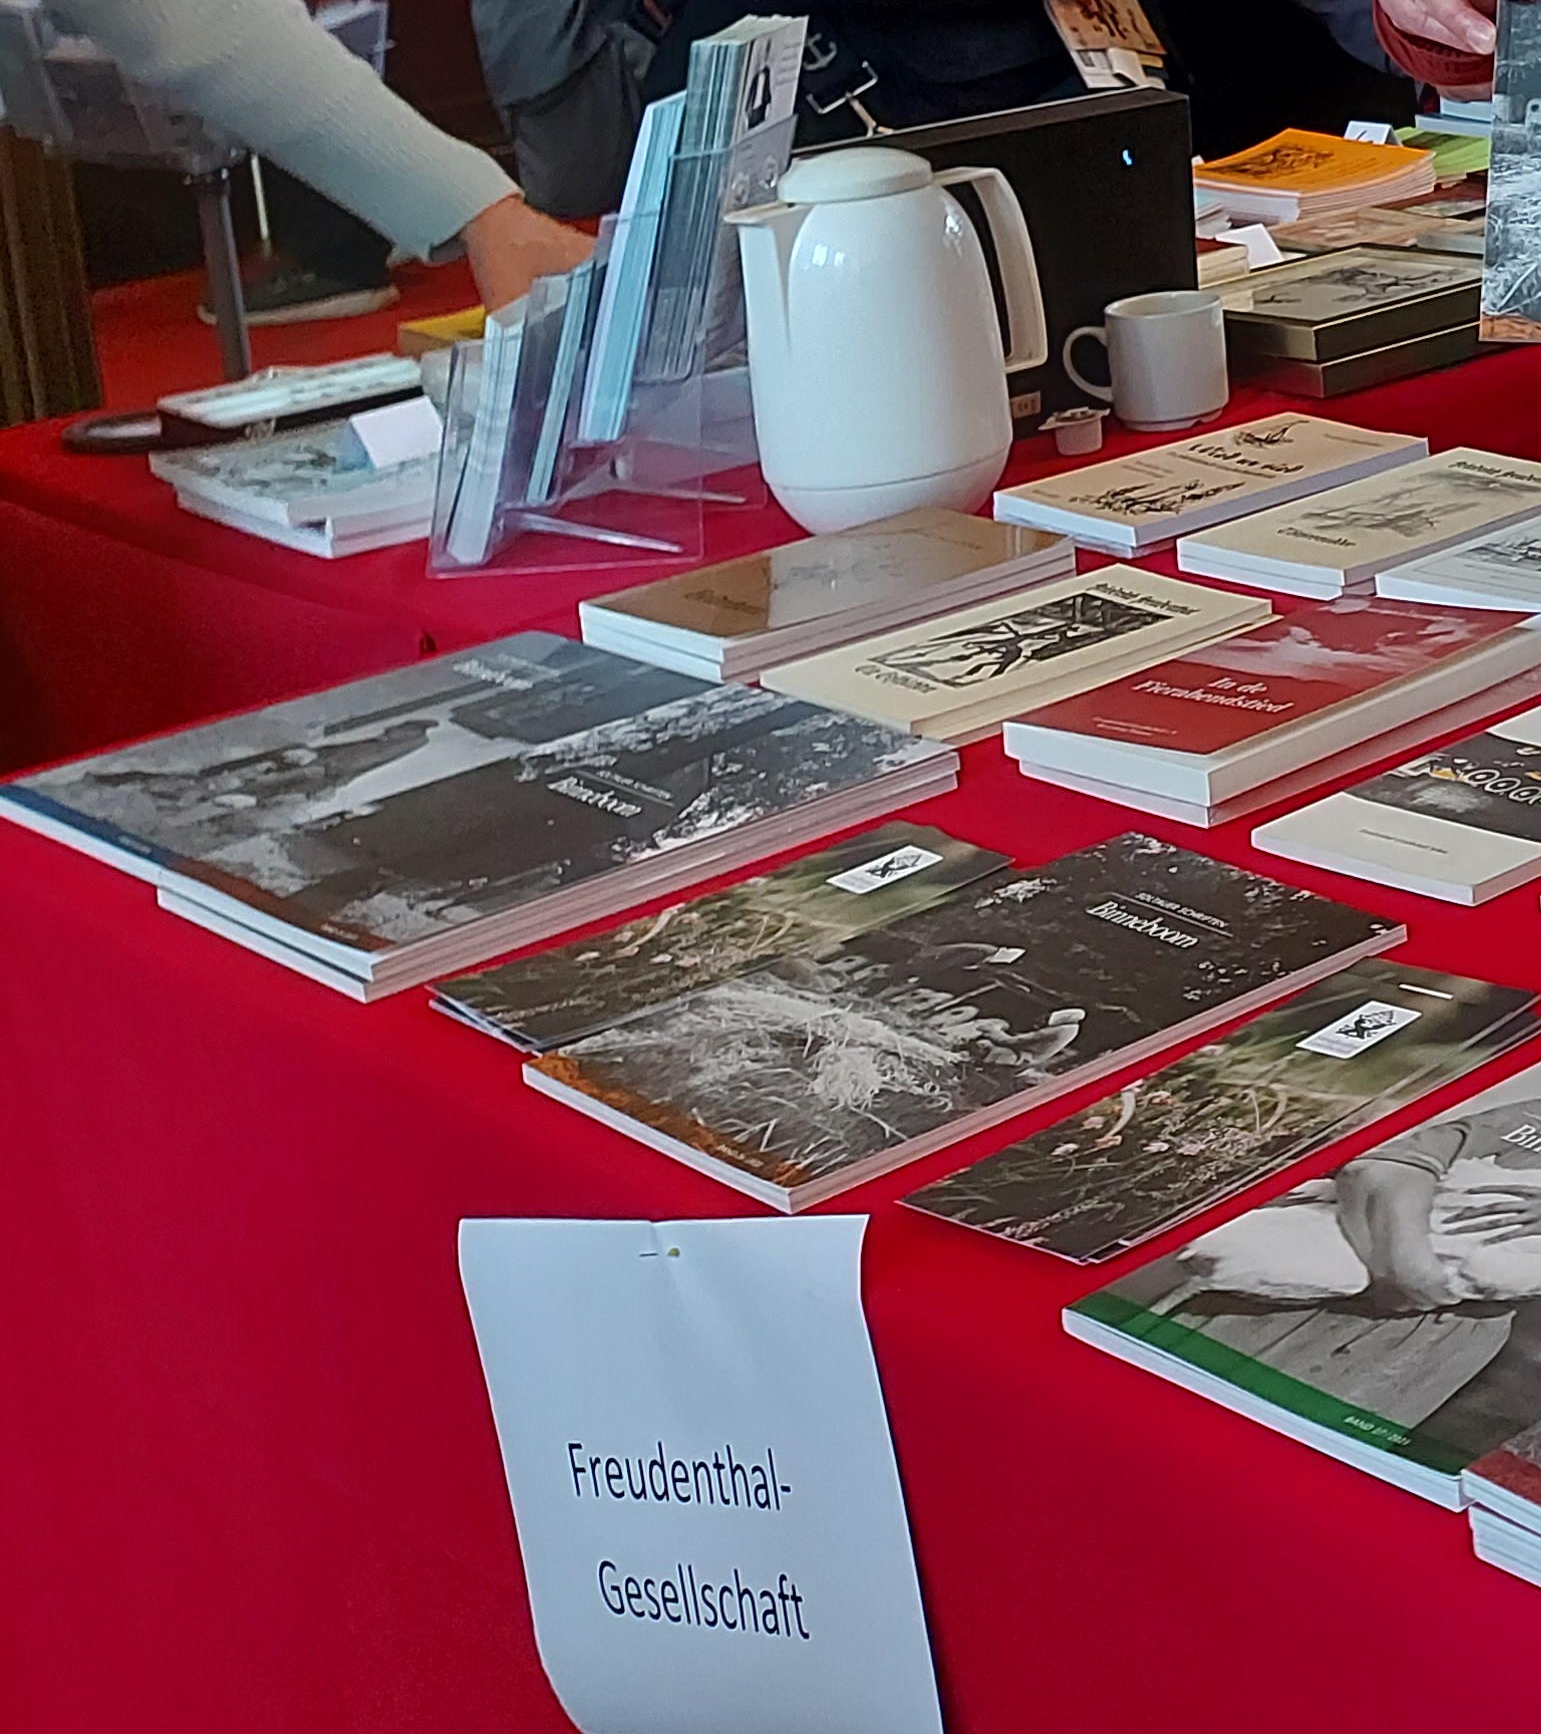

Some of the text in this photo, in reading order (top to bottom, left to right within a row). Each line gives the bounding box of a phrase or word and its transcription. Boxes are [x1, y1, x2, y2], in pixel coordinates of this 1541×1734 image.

[1132, 679, 1295, 715] Fierabendstied
[1208, 676, 1268, 694] In de
[1085, 901, 1199, 949] Binneboom
[567, 1441, 792, 1511] Freudenthal-
[599, 1560, 810, 1640] Gesellschaft
